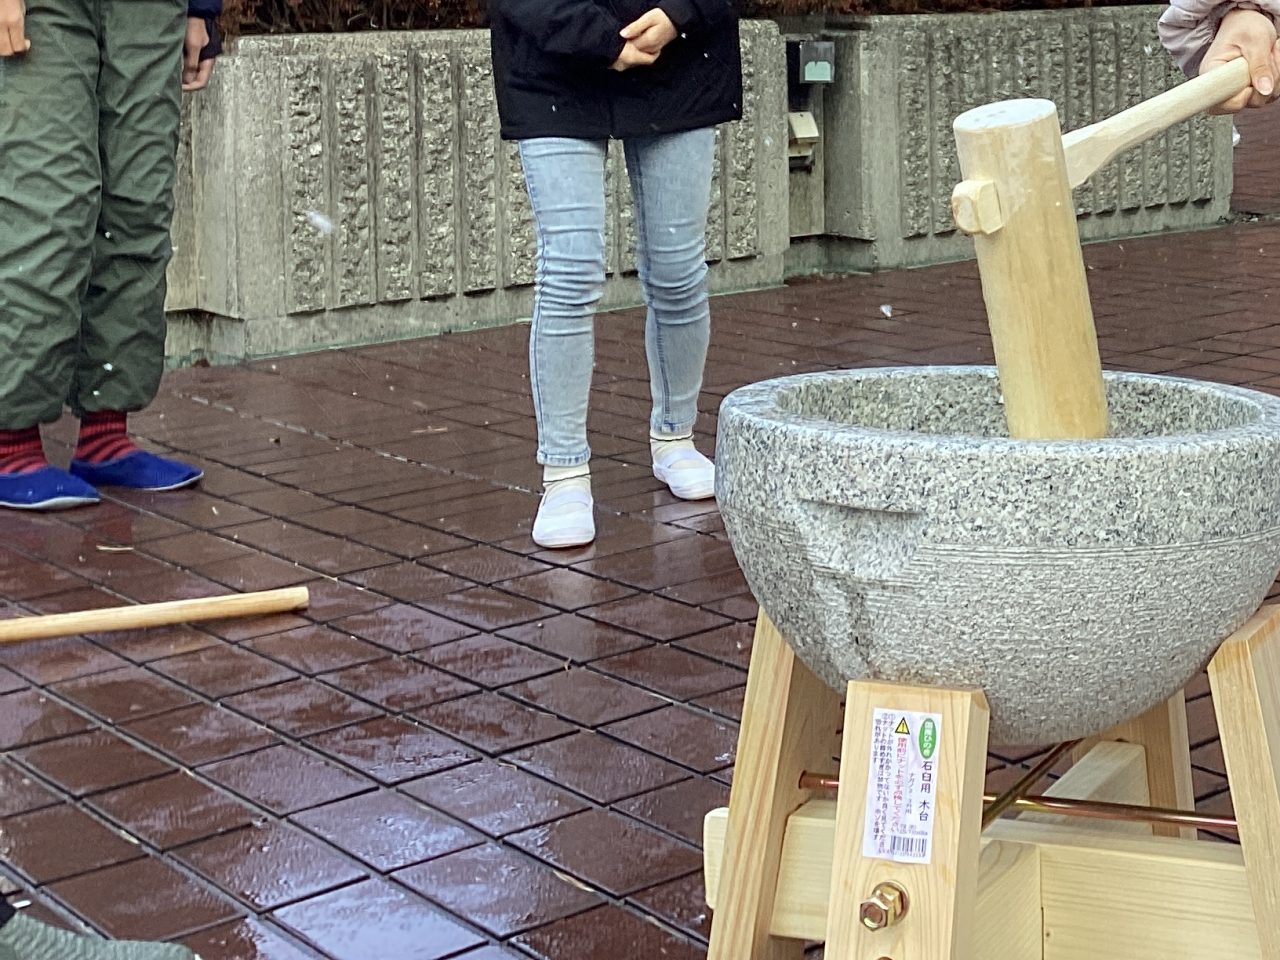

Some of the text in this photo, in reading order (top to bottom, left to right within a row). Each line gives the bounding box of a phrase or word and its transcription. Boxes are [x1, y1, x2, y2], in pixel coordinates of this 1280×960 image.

[918, 761, 933, 821] 石臼用 木台
